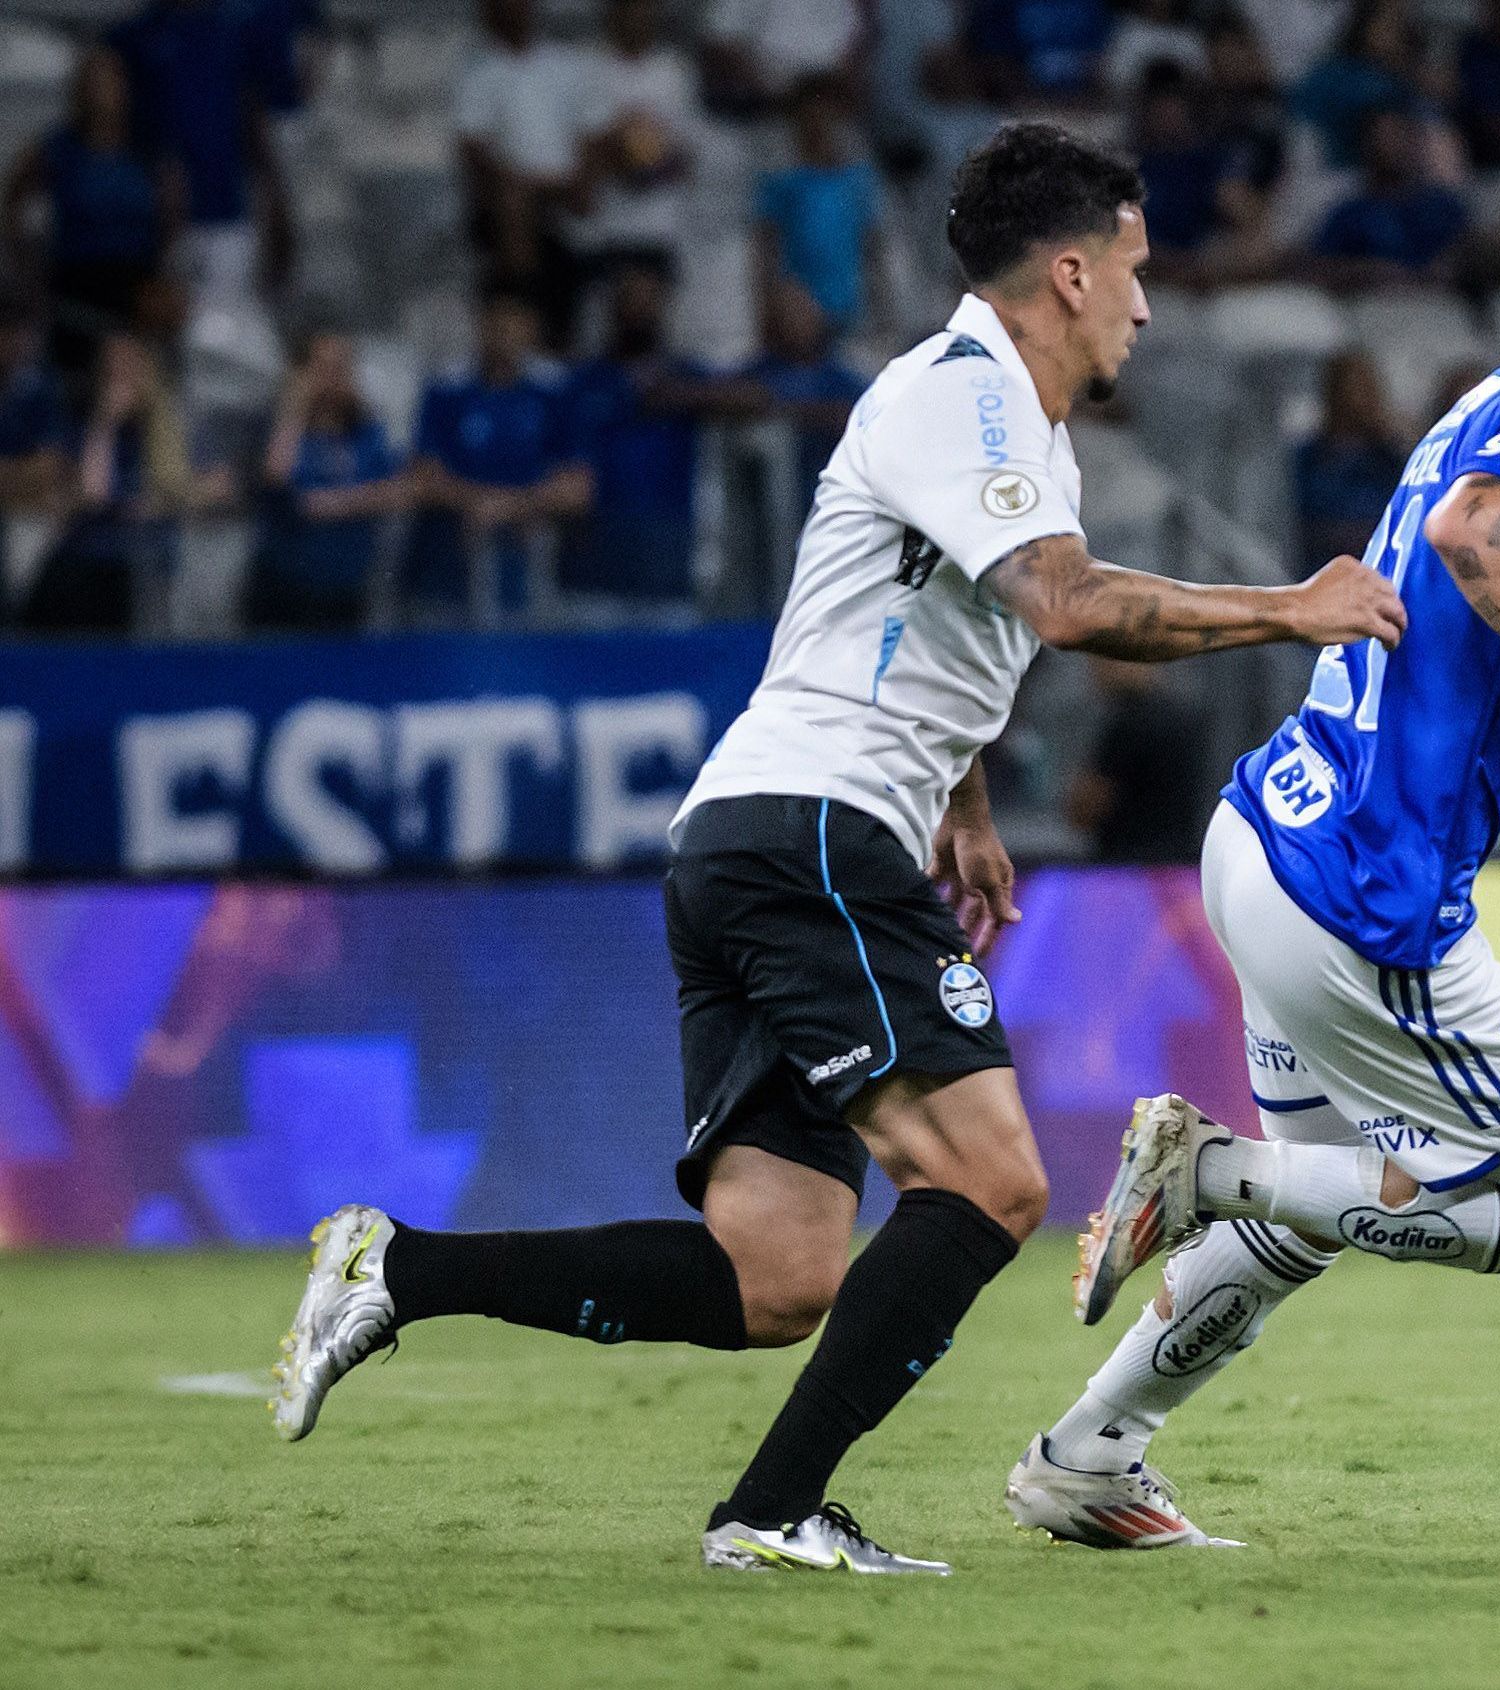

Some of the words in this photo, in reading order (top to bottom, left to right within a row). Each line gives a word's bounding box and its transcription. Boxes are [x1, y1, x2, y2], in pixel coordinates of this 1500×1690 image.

[1270, 758, 1327, 817] BH
[1365, 1126, 1440, 1153] IVIX
[1353, 1216, 1456, 1250] Kodilar
[1164, 1294, 1248, 1371] Kodilar
